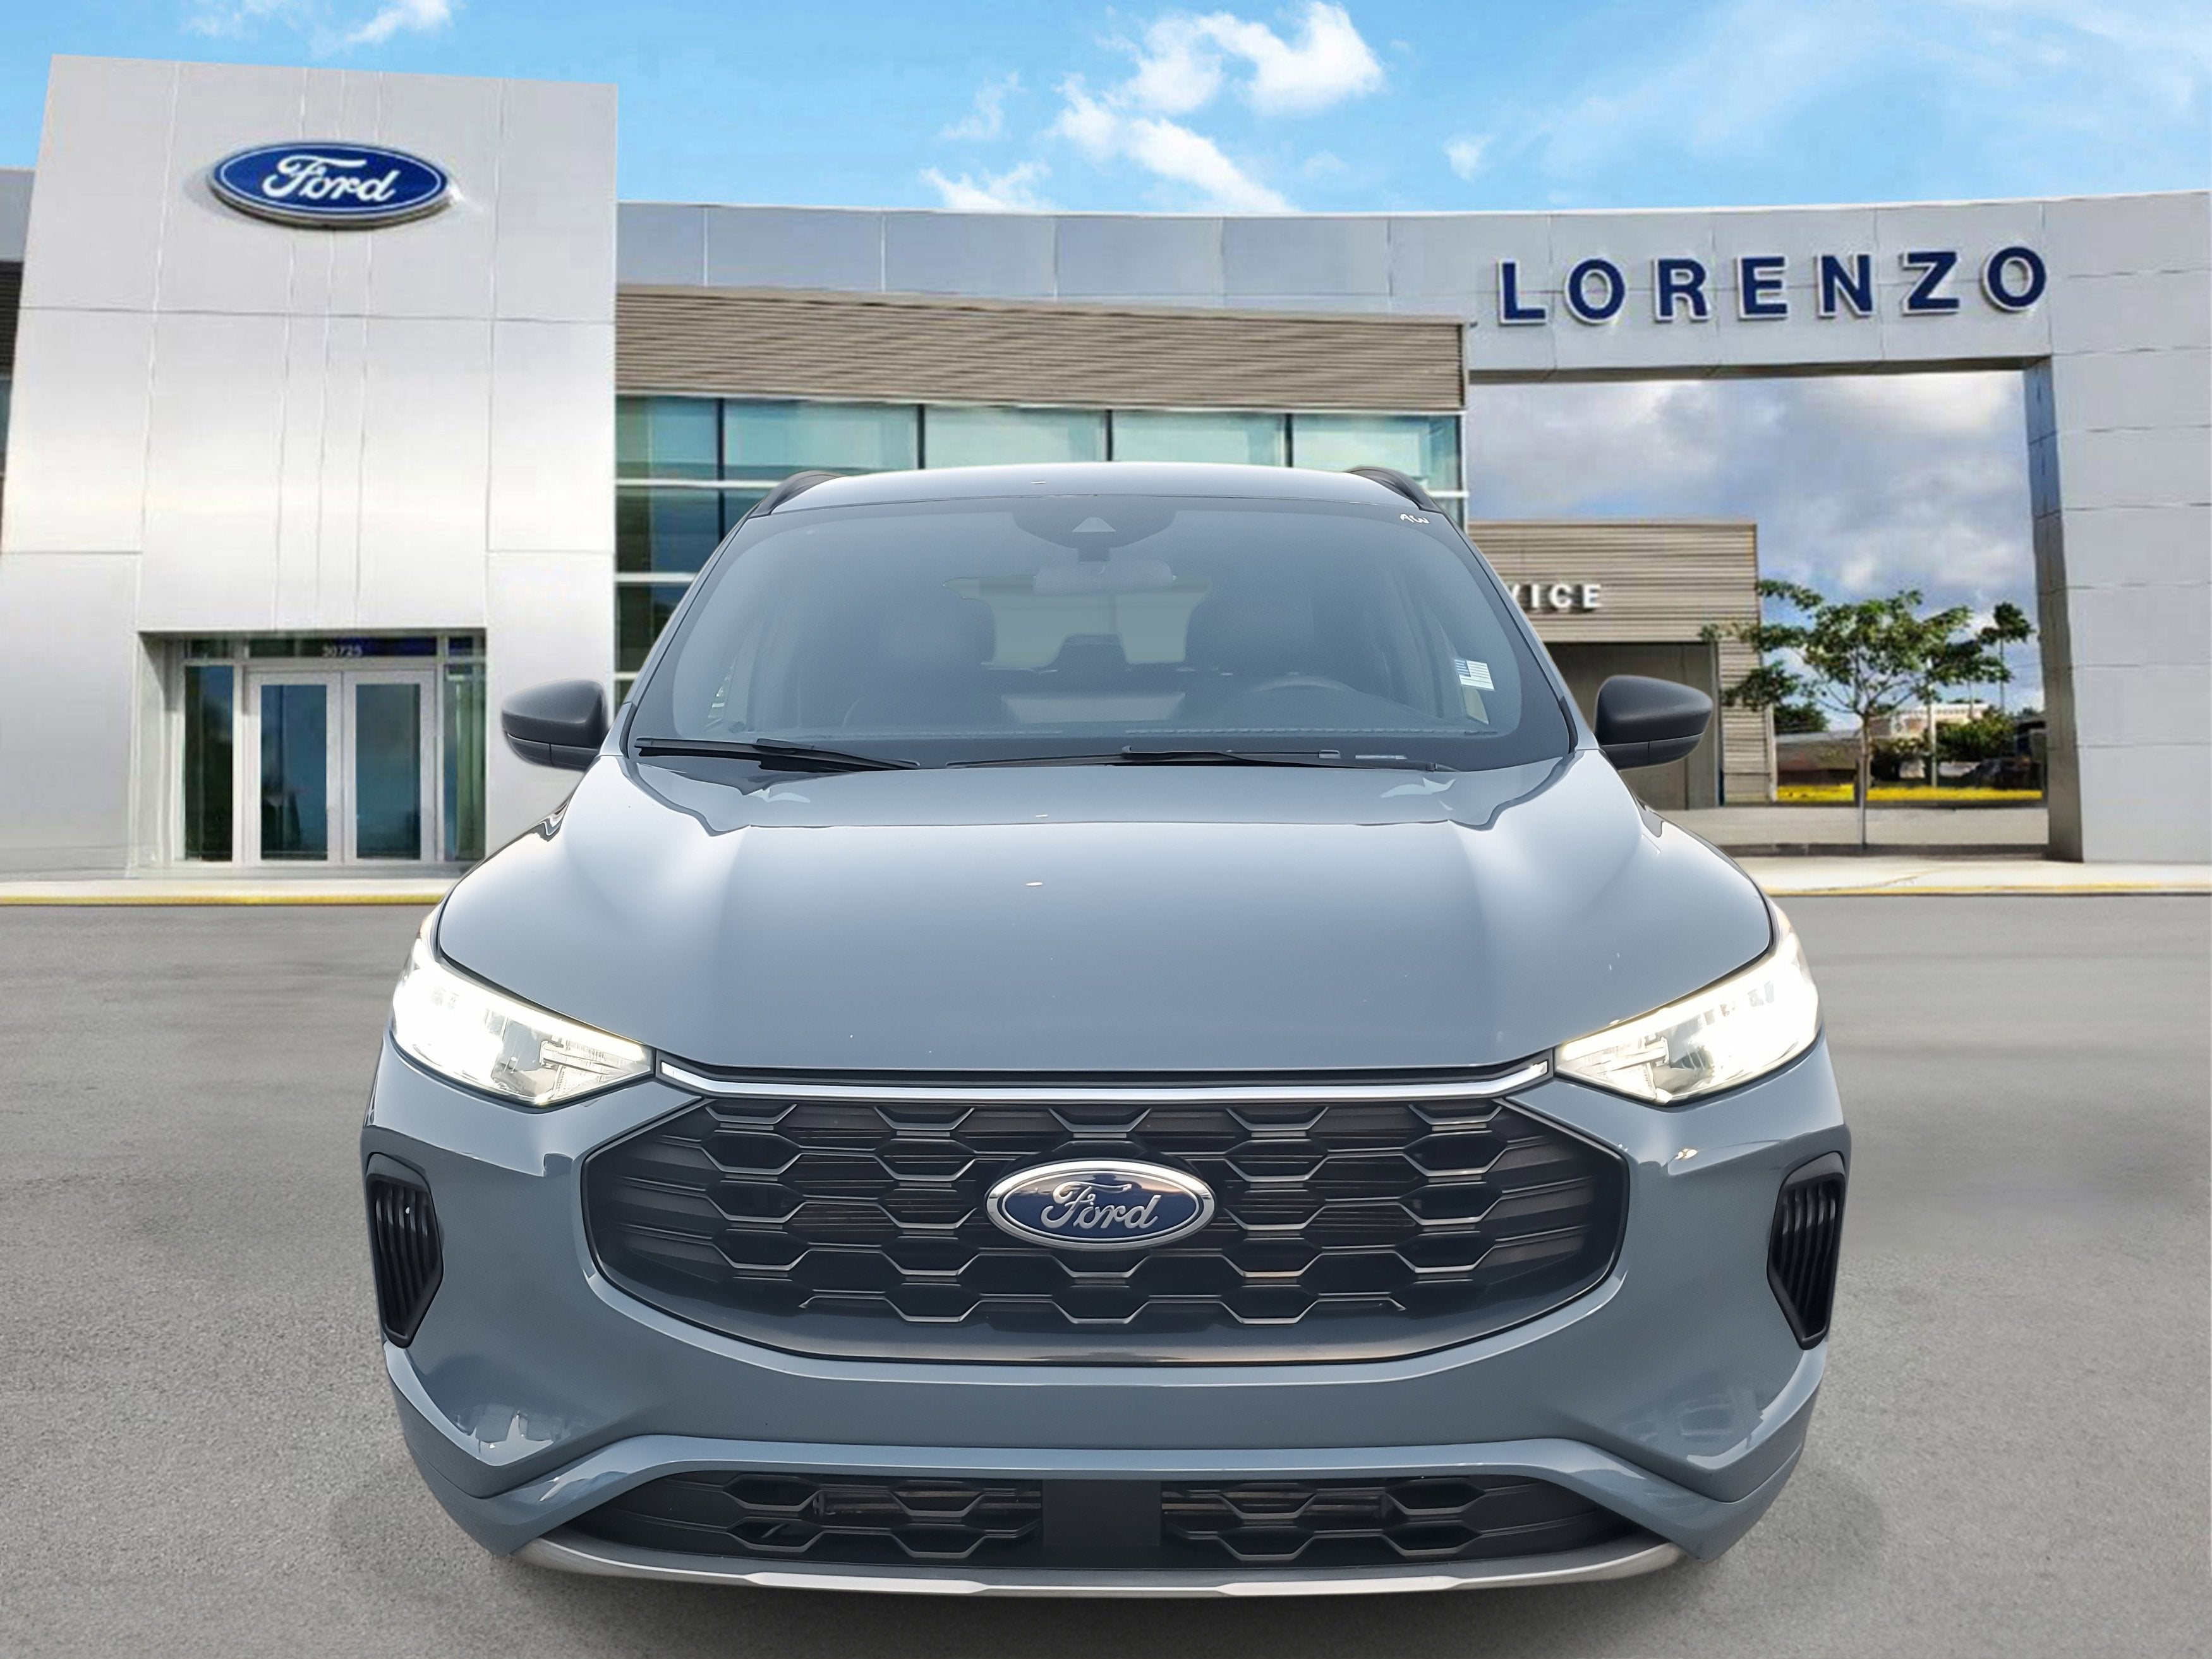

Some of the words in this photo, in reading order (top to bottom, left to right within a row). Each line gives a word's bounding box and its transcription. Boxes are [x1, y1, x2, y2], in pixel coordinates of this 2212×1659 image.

[262, 154, 399, 202] Ford
[1497, 246, 2047, 323] LORENZO
[1041, 1181, 1162, 1229] Ford
